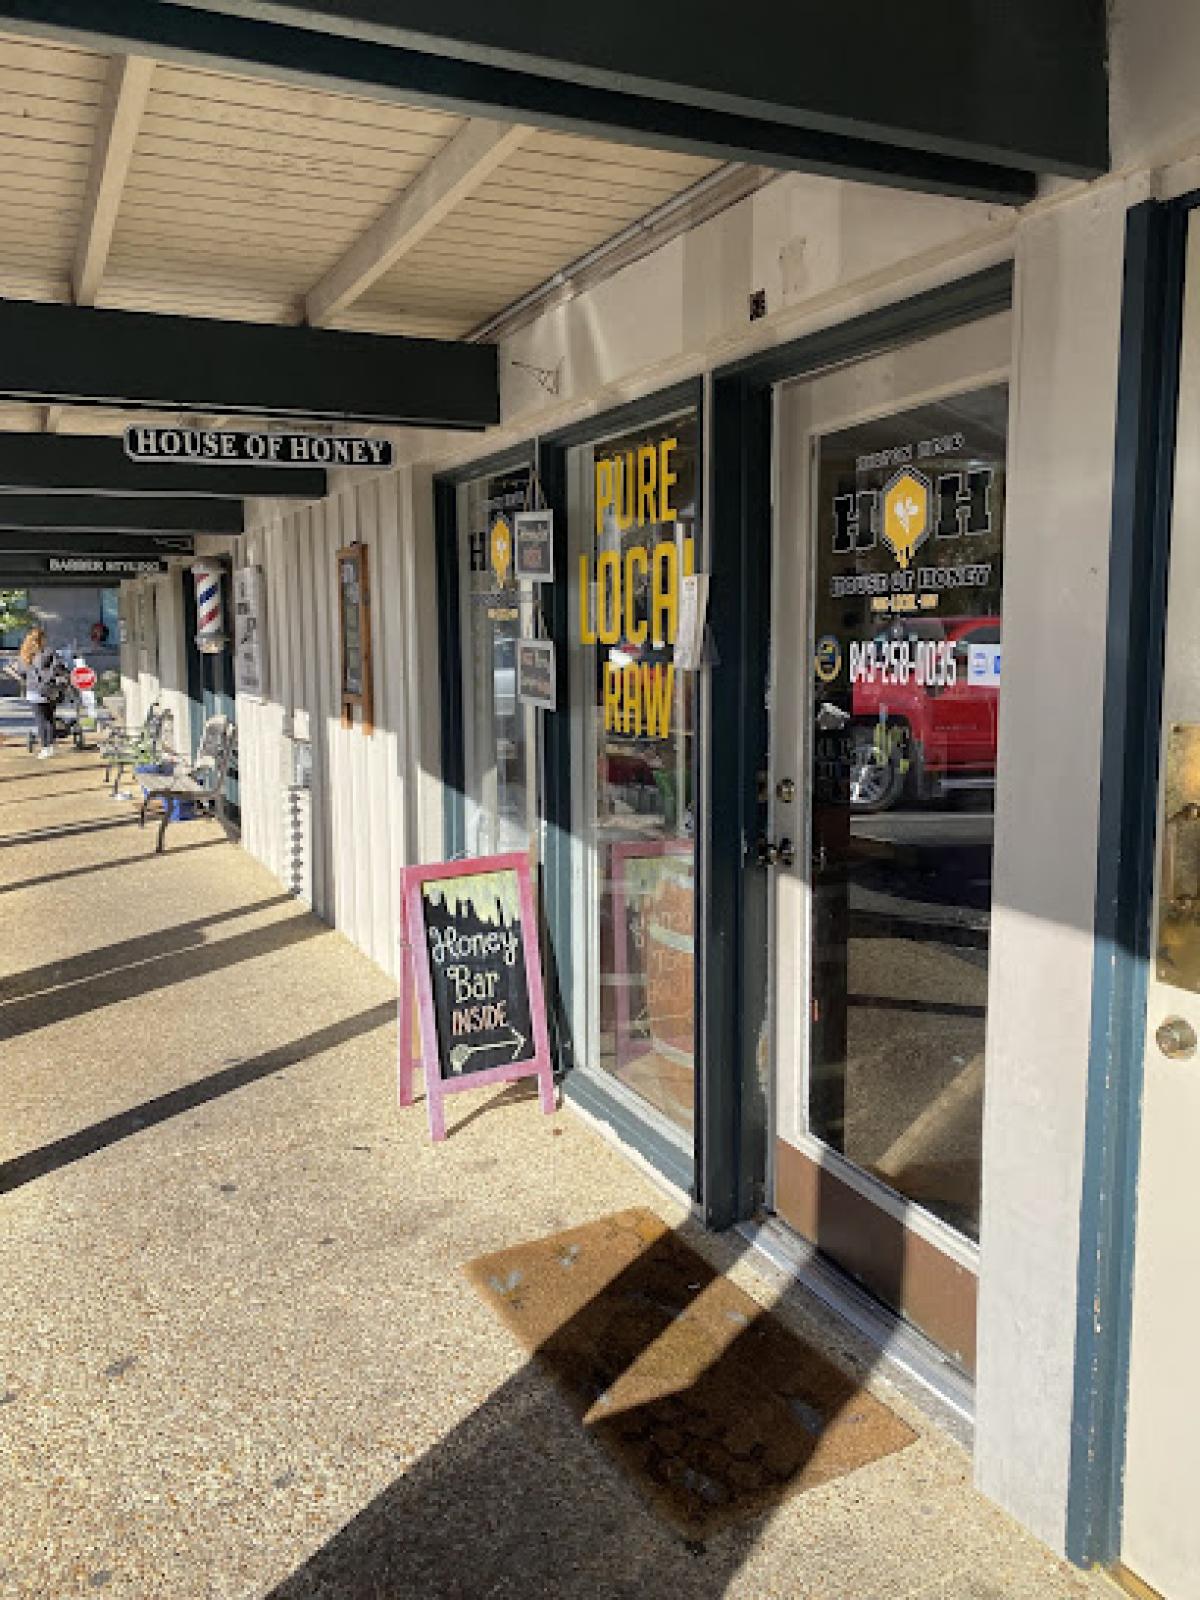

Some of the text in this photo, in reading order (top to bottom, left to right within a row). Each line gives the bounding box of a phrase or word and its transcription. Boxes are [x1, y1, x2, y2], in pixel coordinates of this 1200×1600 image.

[137, 430, 383, 463] HOUSE OF HONEY
[596, 438, 678, 535] PURE
[917, 564, 992, 589] HONEY
[850, 640, 957, 686] 843-258-0035
[602, 661, 675, 739] RAW
[429, 925, 519, 966] Honey
[446, 964, 499, 1003] Bar
[452, 1000, 508, 1036] INSIDE
